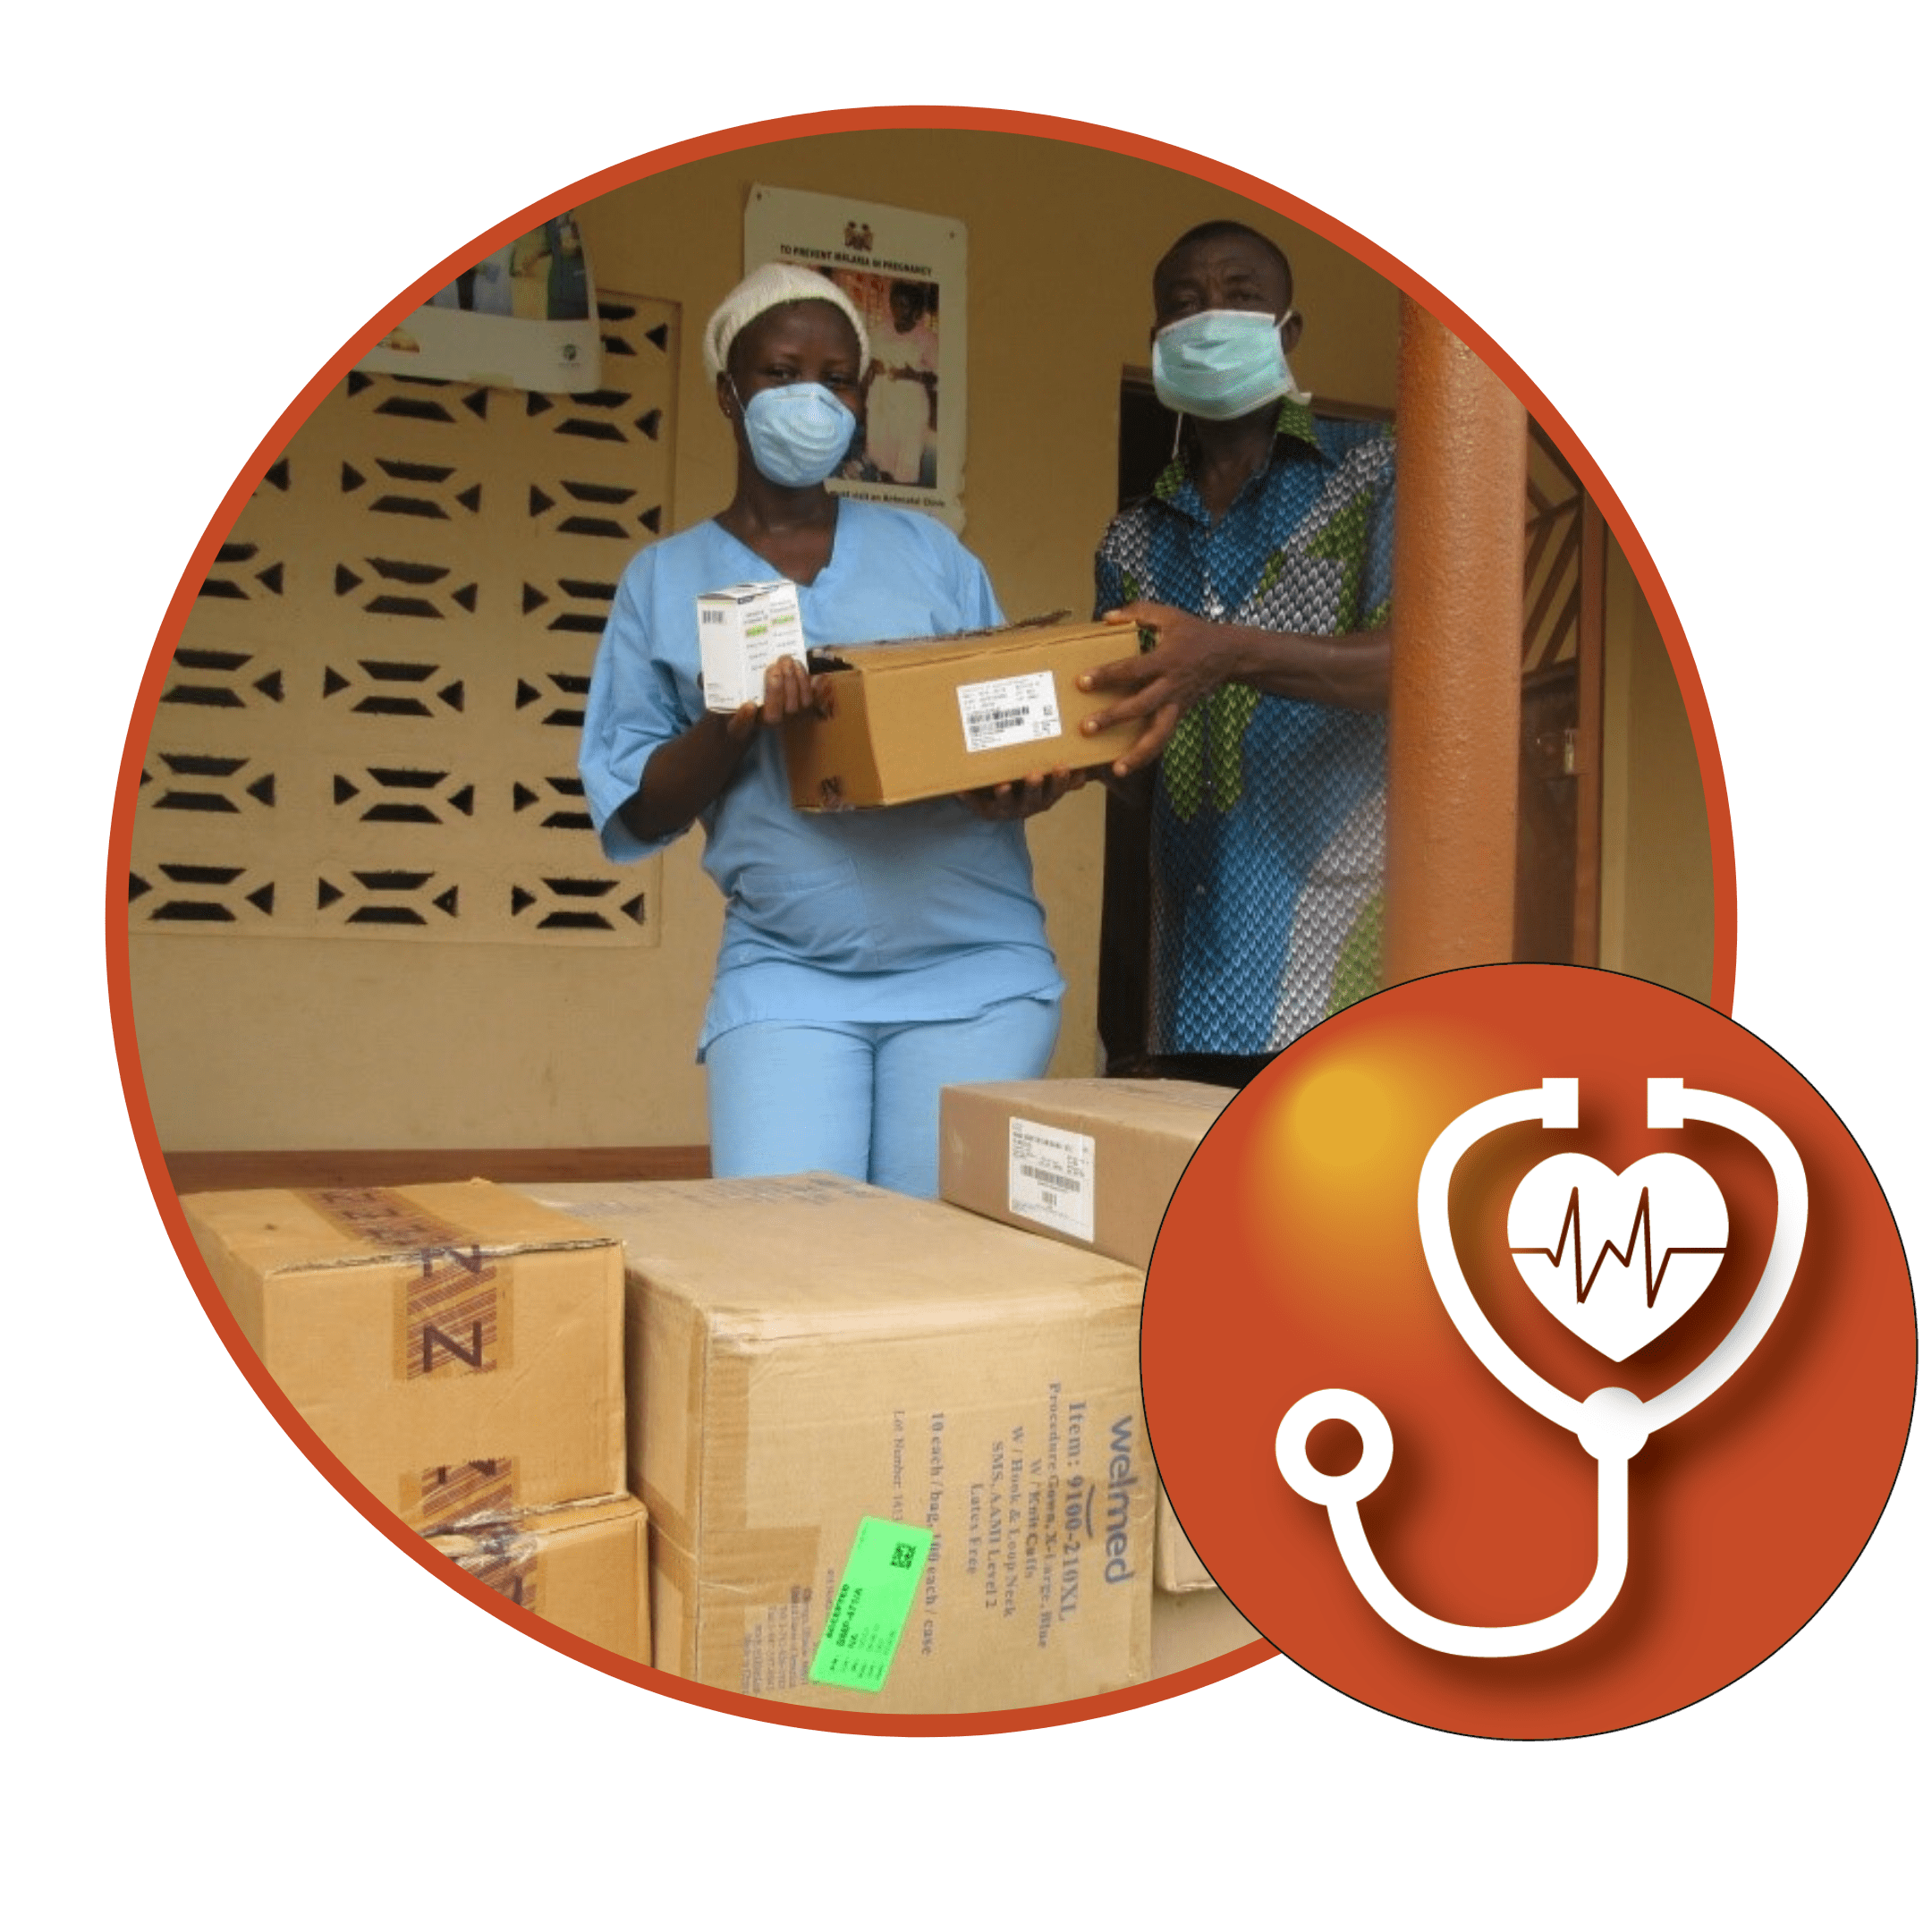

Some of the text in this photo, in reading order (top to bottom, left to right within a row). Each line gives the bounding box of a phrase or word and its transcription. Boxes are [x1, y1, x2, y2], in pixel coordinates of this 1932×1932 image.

[780, 243, 792, 256] TO
[792, 245, 832, 261] PREVENT
[833, 250, 871, 267] MALARIA
[882, 258, 932, 276] PREGNANCY
[930, 1412, 945, 1432] 10
[1010, 1425, 1025, 1444] W
[1046, 1381, 1062, 1473] Procedure
[928, 1436, 944, 1477] each
[1030, 1457, 1043, 1477] W
[1008, 1458, 1024, 1504] Hook
[1043, 1474, 1060, 1527] Gown,
[1103, 1413, 1138, 1585] welmed
[926, 1489, 944, 1529] bag,
[965, 1482, 985, 1575] Latex Free
[987, 1491, 1003, 1545] AAMI
[1008, 1507, 1021, 1524] &
[1027, 1489, 1041, 1529] Knit
[1058, 1400, 1088, 1623] Item: 9100-210XL
[1002, 1527, 1021, 1572] Loop
[1024, 1532, 1040, 1580] Cuffs
[925, 1565, 940, 1606] each
[986, 1548, 1001, 1595] Level
[985, 1597, 998, 1610] 2
[1001, 1572, 1019, 1620] Neck
[920, 1619, 936, 1657] case
[1037, 1609, 1052, 1649] Blue
